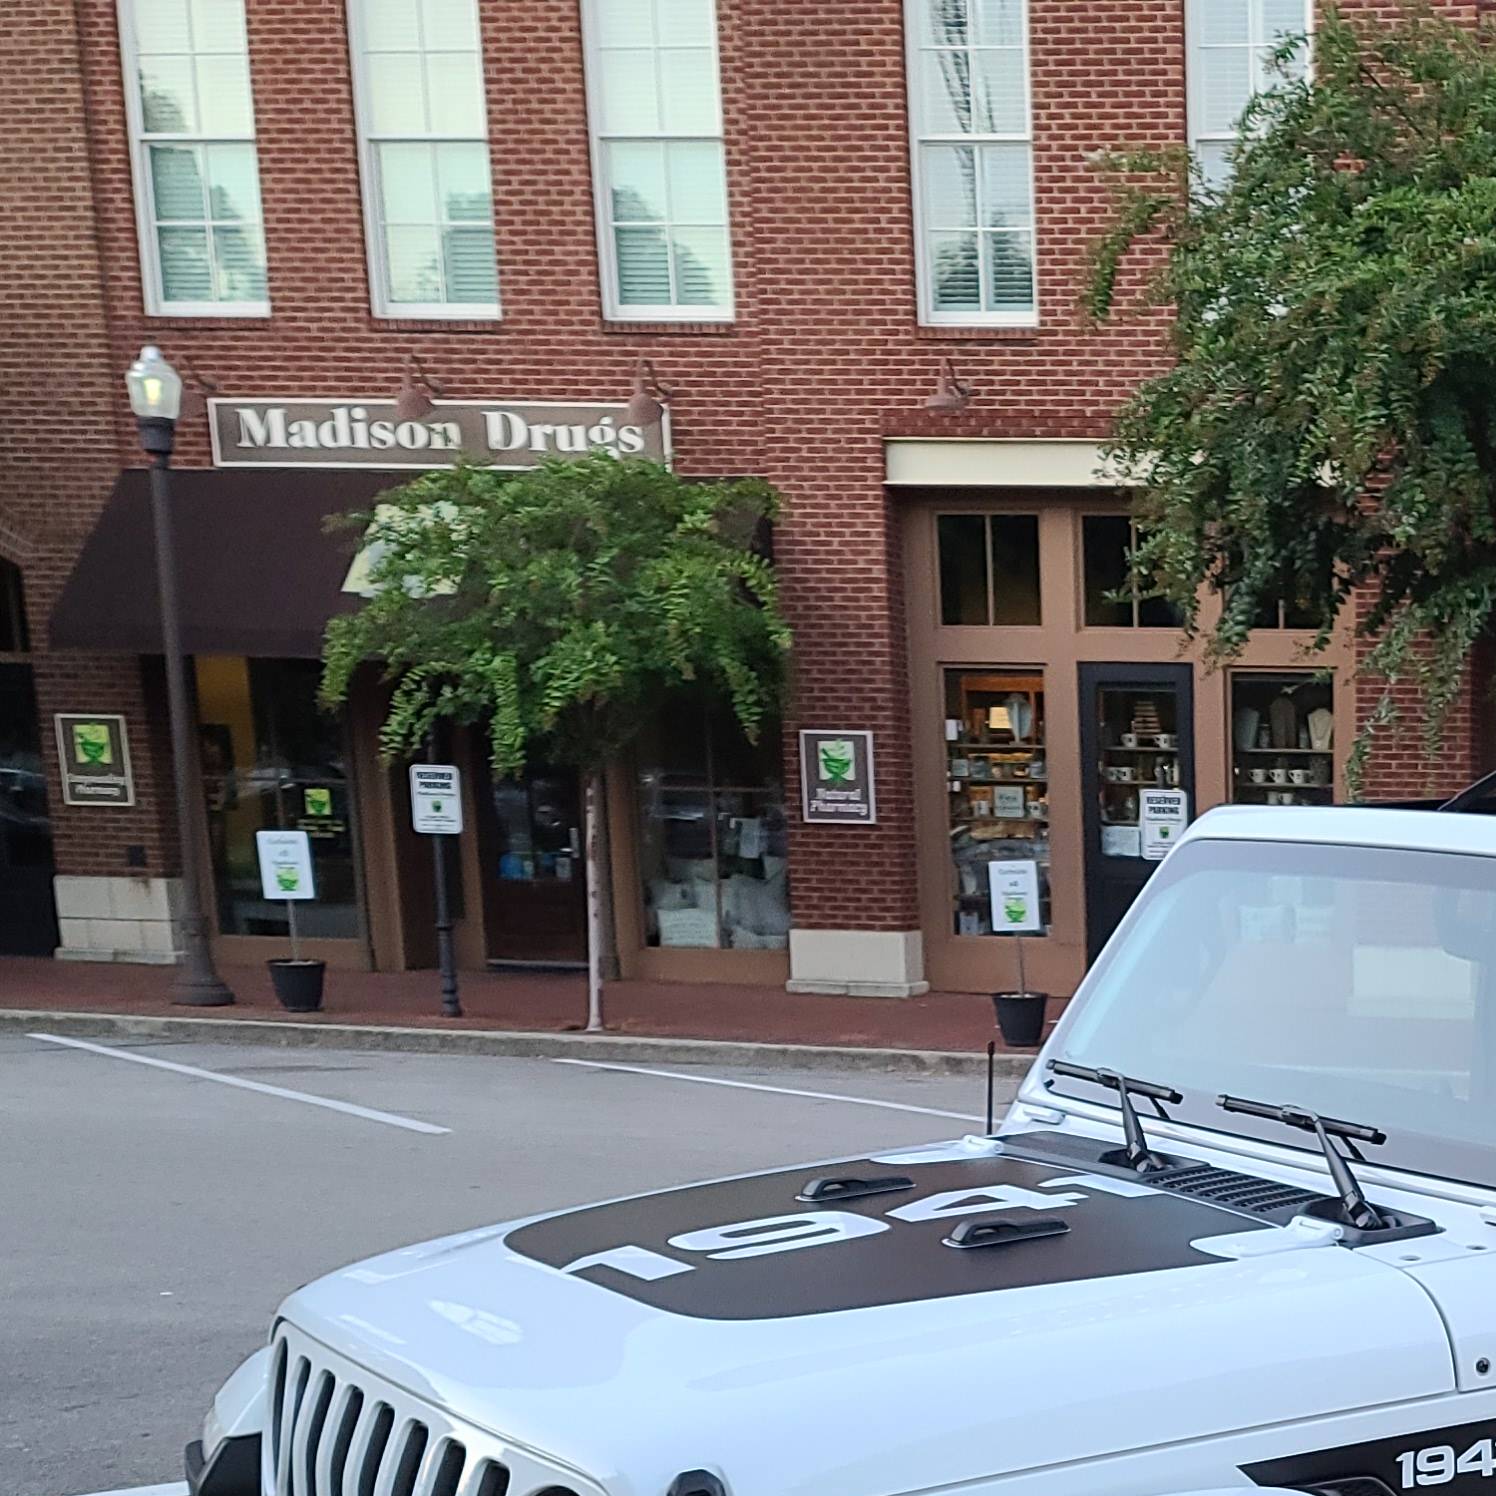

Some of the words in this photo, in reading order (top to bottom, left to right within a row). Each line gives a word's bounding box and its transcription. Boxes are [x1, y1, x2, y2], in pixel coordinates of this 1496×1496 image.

[235, 407, 462, 450] Madison
[481, 411, 645, 461] Drugs
[815, 787, 862, 800] Natural
[810, 800, 868, 816] Pharmacy
[1148, 806, 1180, 814] PARKING
[562, 1172, 1168, 1283] 1941
